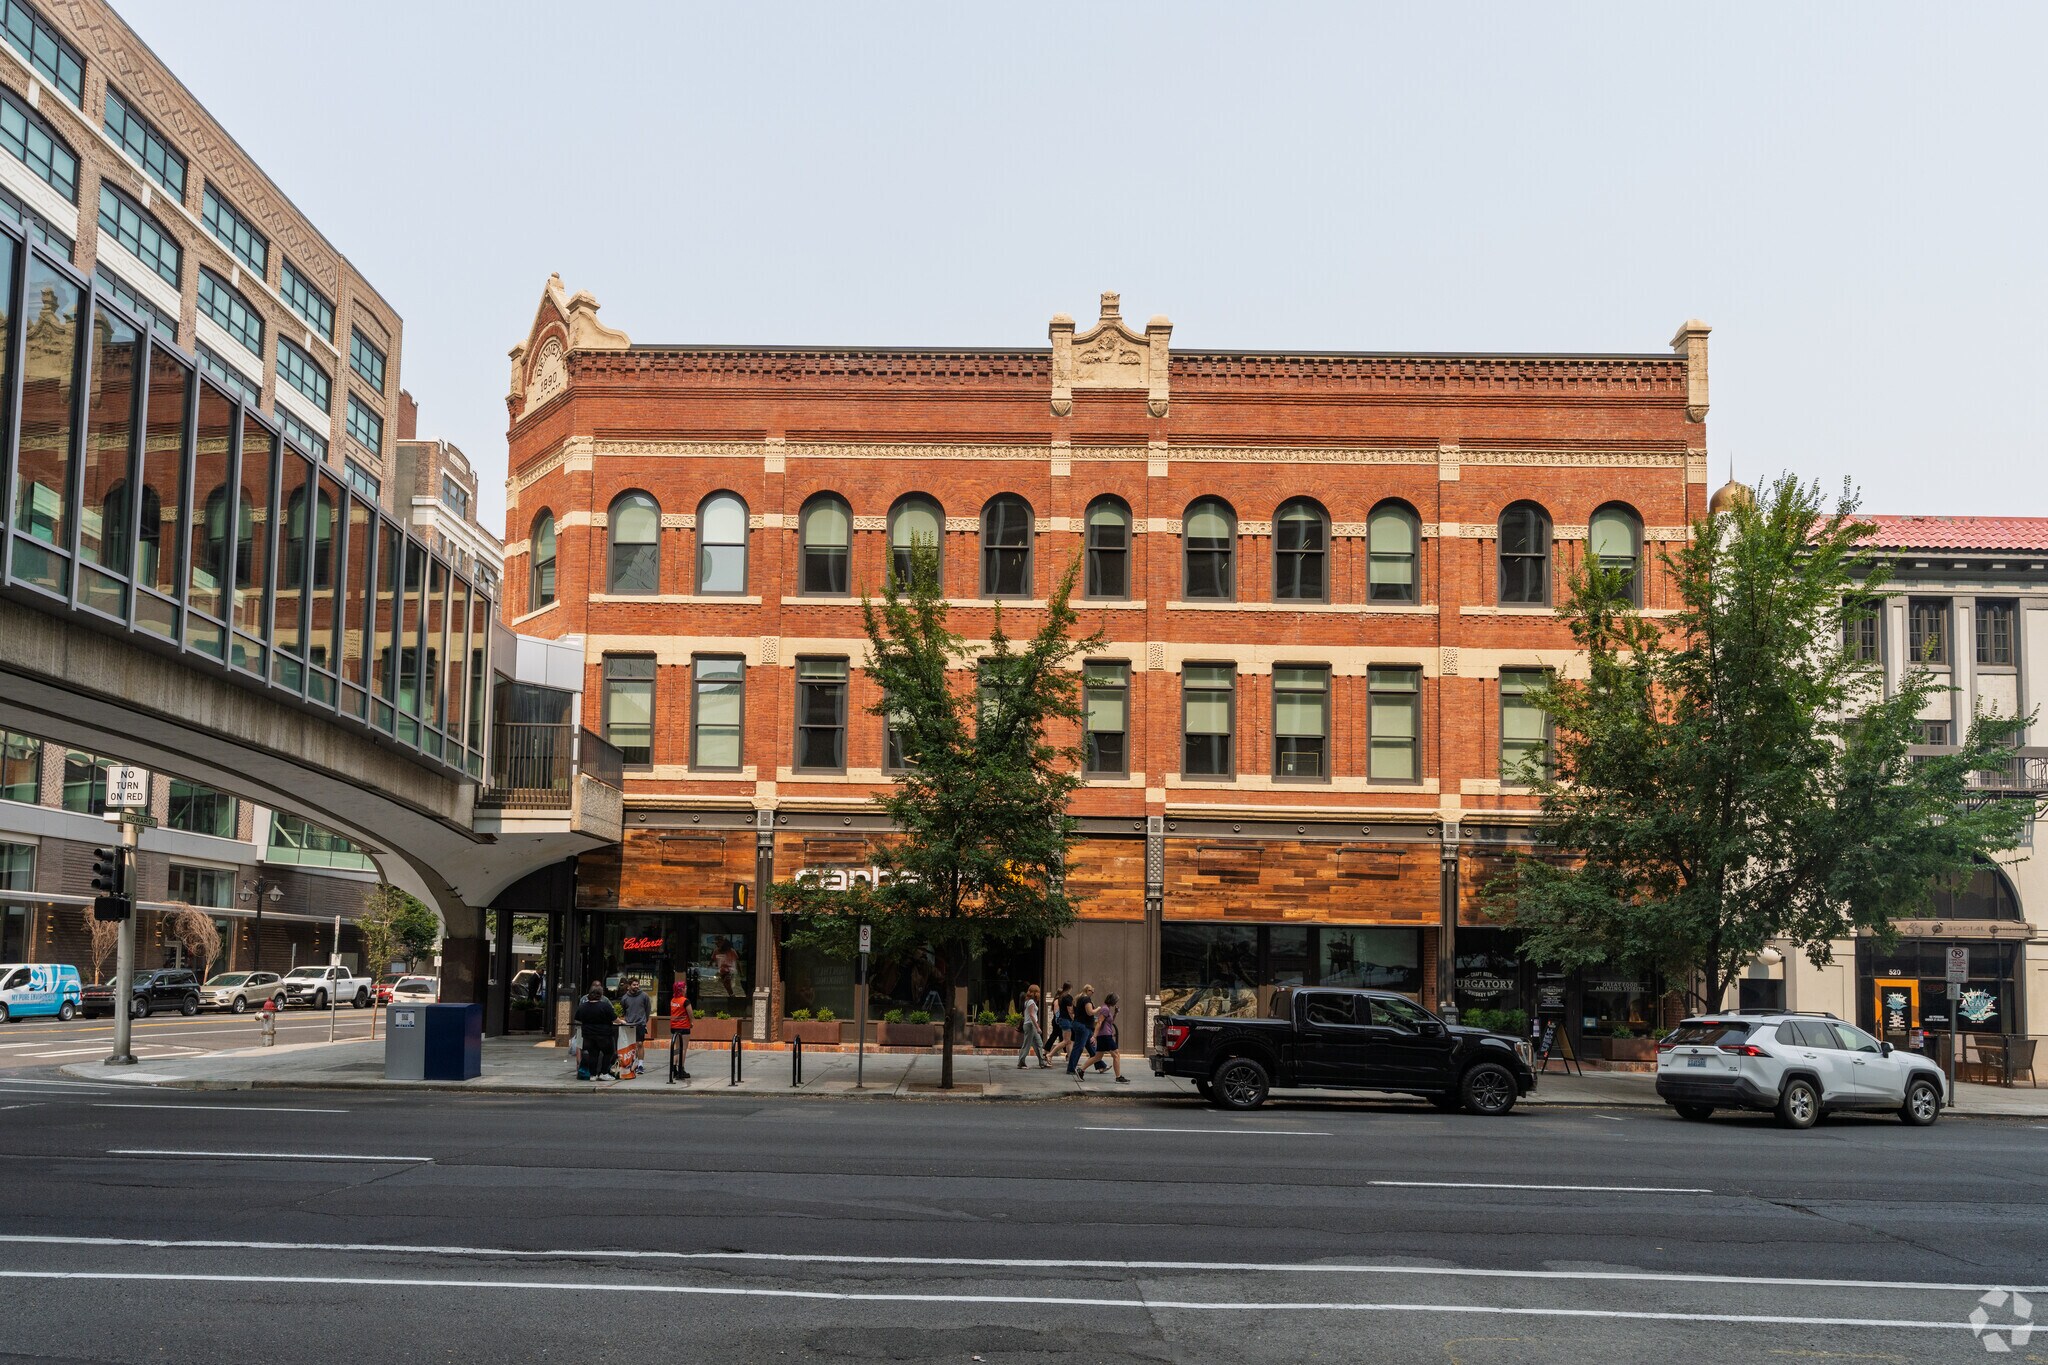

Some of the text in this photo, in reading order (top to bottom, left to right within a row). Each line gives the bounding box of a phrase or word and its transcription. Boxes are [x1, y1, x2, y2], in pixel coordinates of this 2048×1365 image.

[540, 371, 557, 393] 1890
[120, 770, 135, 779] NO
[116, 781, 139, 790] TURN
[110, 792, 143, 801] ON RED
[126, 814, 153, 826] HOWARD
[623, 937, 663, 949] Carhartt
[1888, 968, 1901, 976] 520
[1455, 979, 1514, 989] URGATORY
[1961, 999, 1994, 1007] AGAVE
